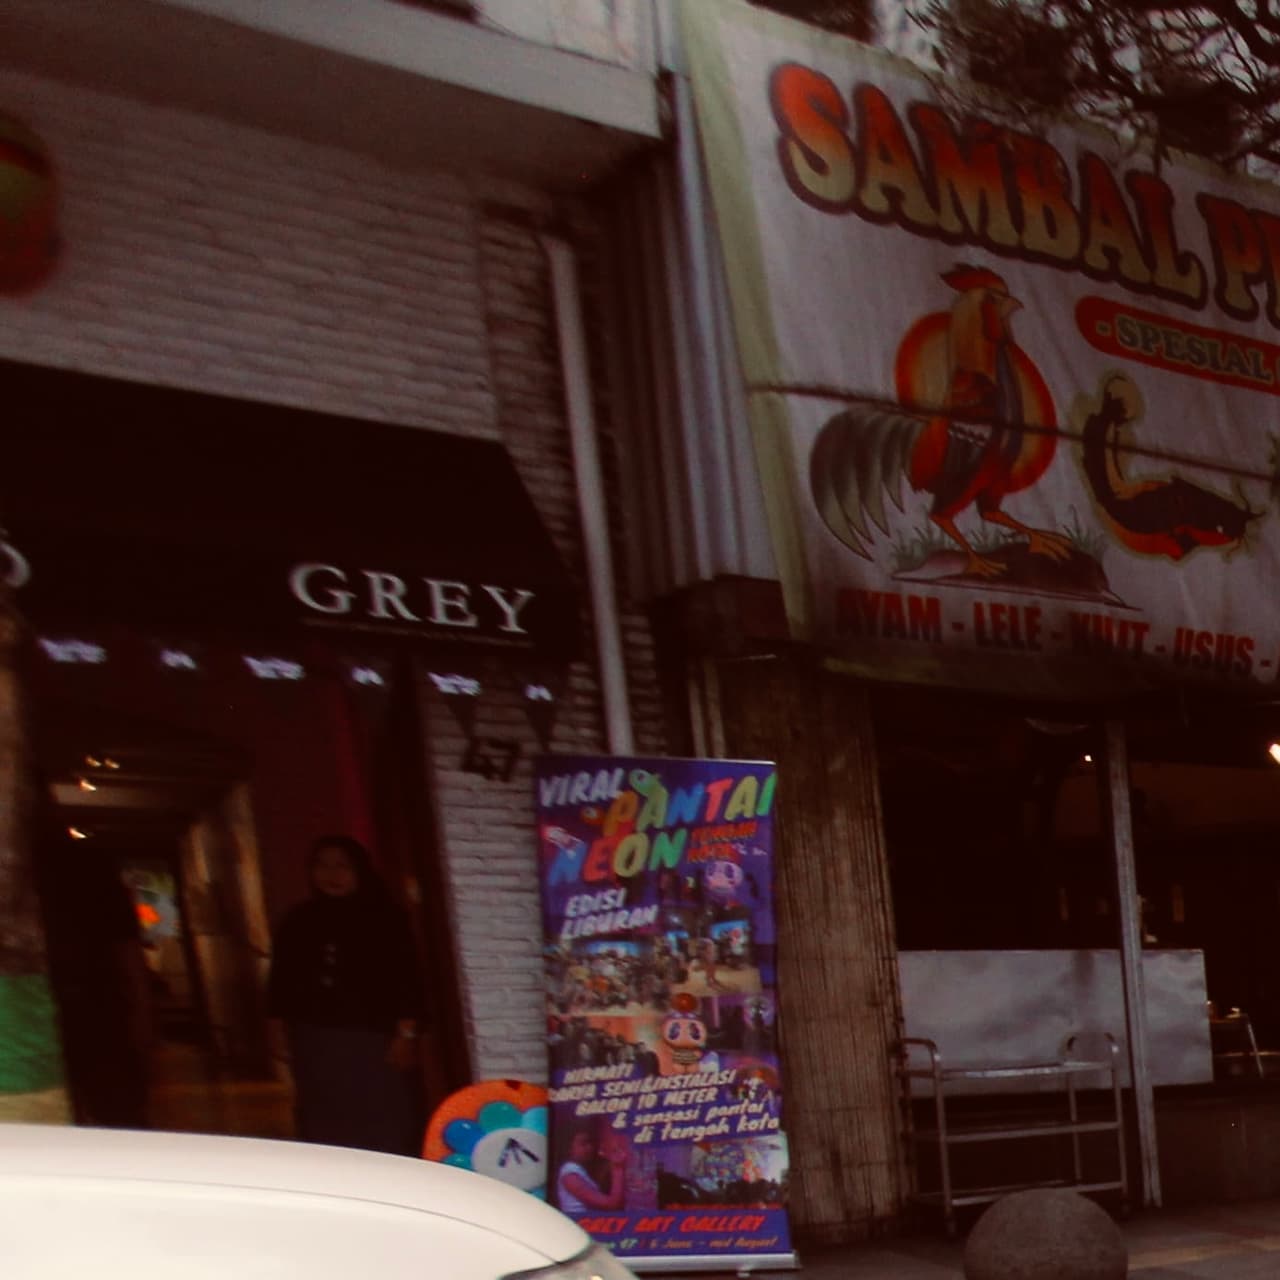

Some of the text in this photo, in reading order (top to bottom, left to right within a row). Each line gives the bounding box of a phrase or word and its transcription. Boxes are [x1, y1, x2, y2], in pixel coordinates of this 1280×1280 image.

[769, 63, 1208, 311] SAMBAL
[1114, 312, 1275, 386] SPESIAL
[287, 562, 537, 634] GREY
[832, 587, 942, 645] AYAM
[973, 602, 1042, 651] LELE
[1172, 627, 1254, 674] USUS
[540, 767, 625, 808] VIRAL
[603, 771, 778, 836] PANTAI
[549, 828, 687, 886] NEON
[561, 905, 659, 940] LIBURAN
[565, 887, 627, 918] EDISI
[634, 1106, 700, 1126] sensasi
[705, 1101, 764, 1122] pantai
[663, 1087, 719, 1106] METER
[634, 1113, 781, 1143] di tengah kota
[633, 1216, 676, 1233] ART
[679, 1215, 768, 1233] GALLERY
